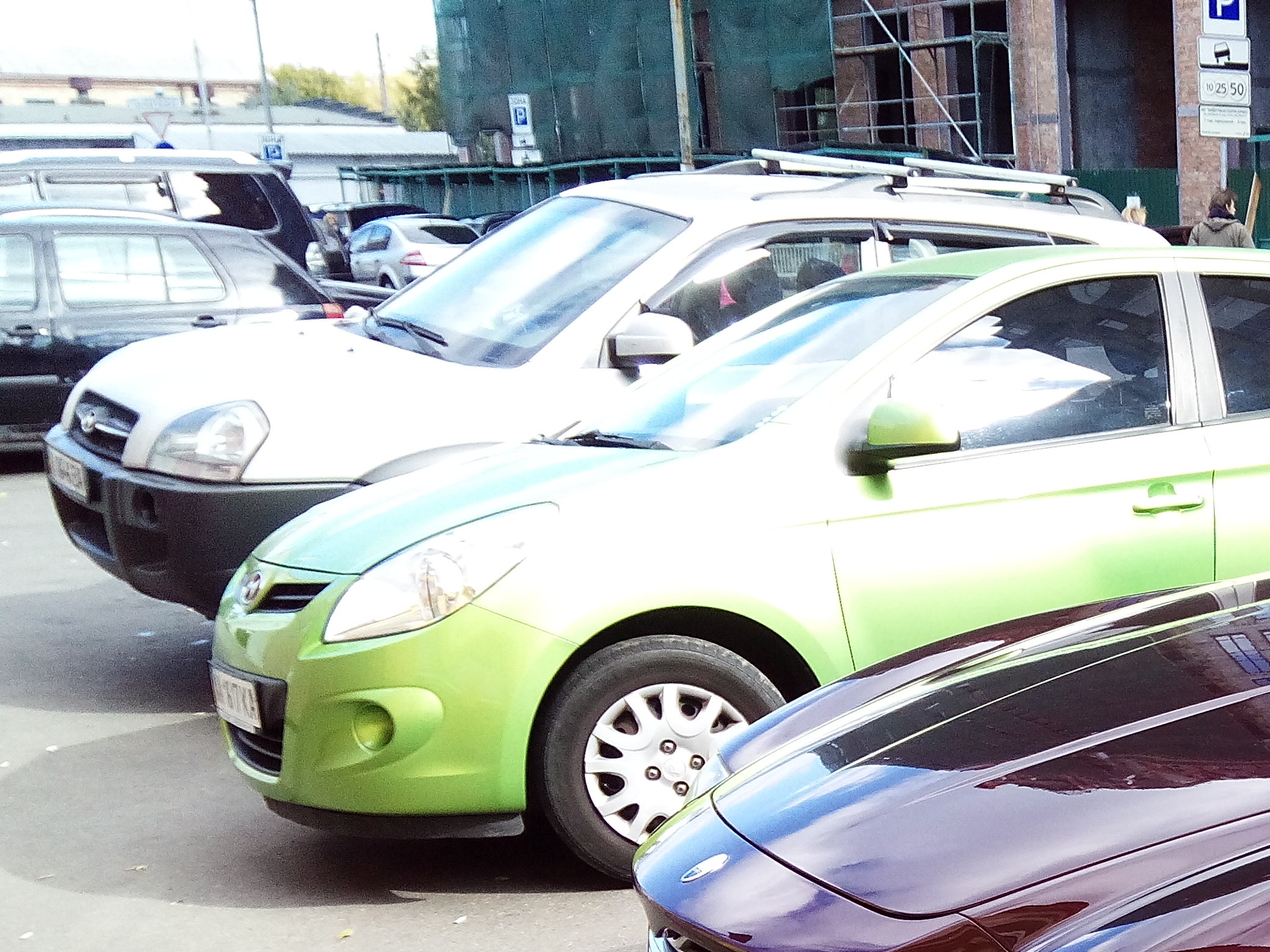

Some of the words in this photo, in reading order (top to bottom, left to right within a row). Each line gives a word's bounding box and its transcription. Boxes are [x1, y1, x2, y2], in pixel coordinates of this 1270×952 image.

[1206, 83, 1214, 92] 10
[1216, 82, 1227, 94] 25
[1230, 82, 1244, 96] 50
